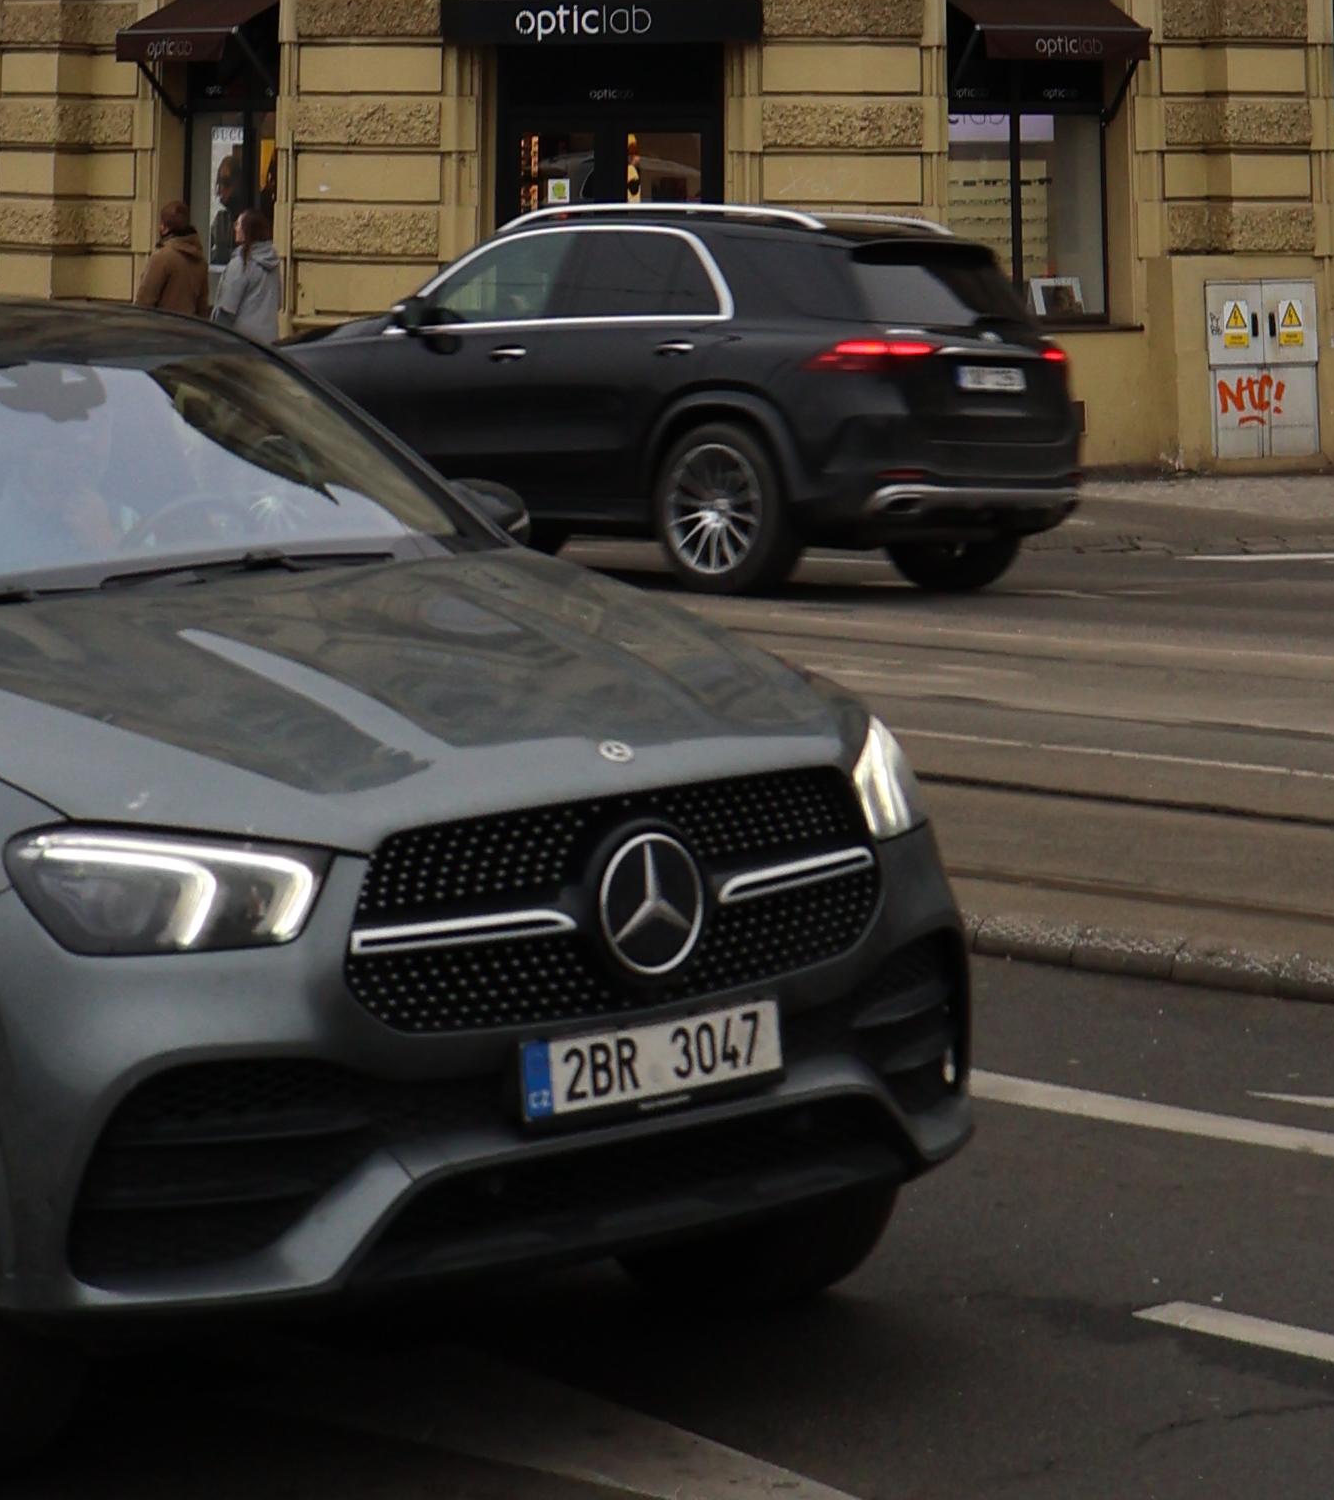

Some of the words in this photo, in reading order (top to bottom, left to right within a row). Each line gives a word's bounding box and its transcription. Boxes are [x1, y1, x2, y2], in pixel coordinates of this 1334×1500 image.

[515, 4, 652, 43] opticlab
[1035, 35, 1103, 58] opticlab
[564, 1038, 640, 1101] 2BR
[671, 1011, 758, 1079] 3047
